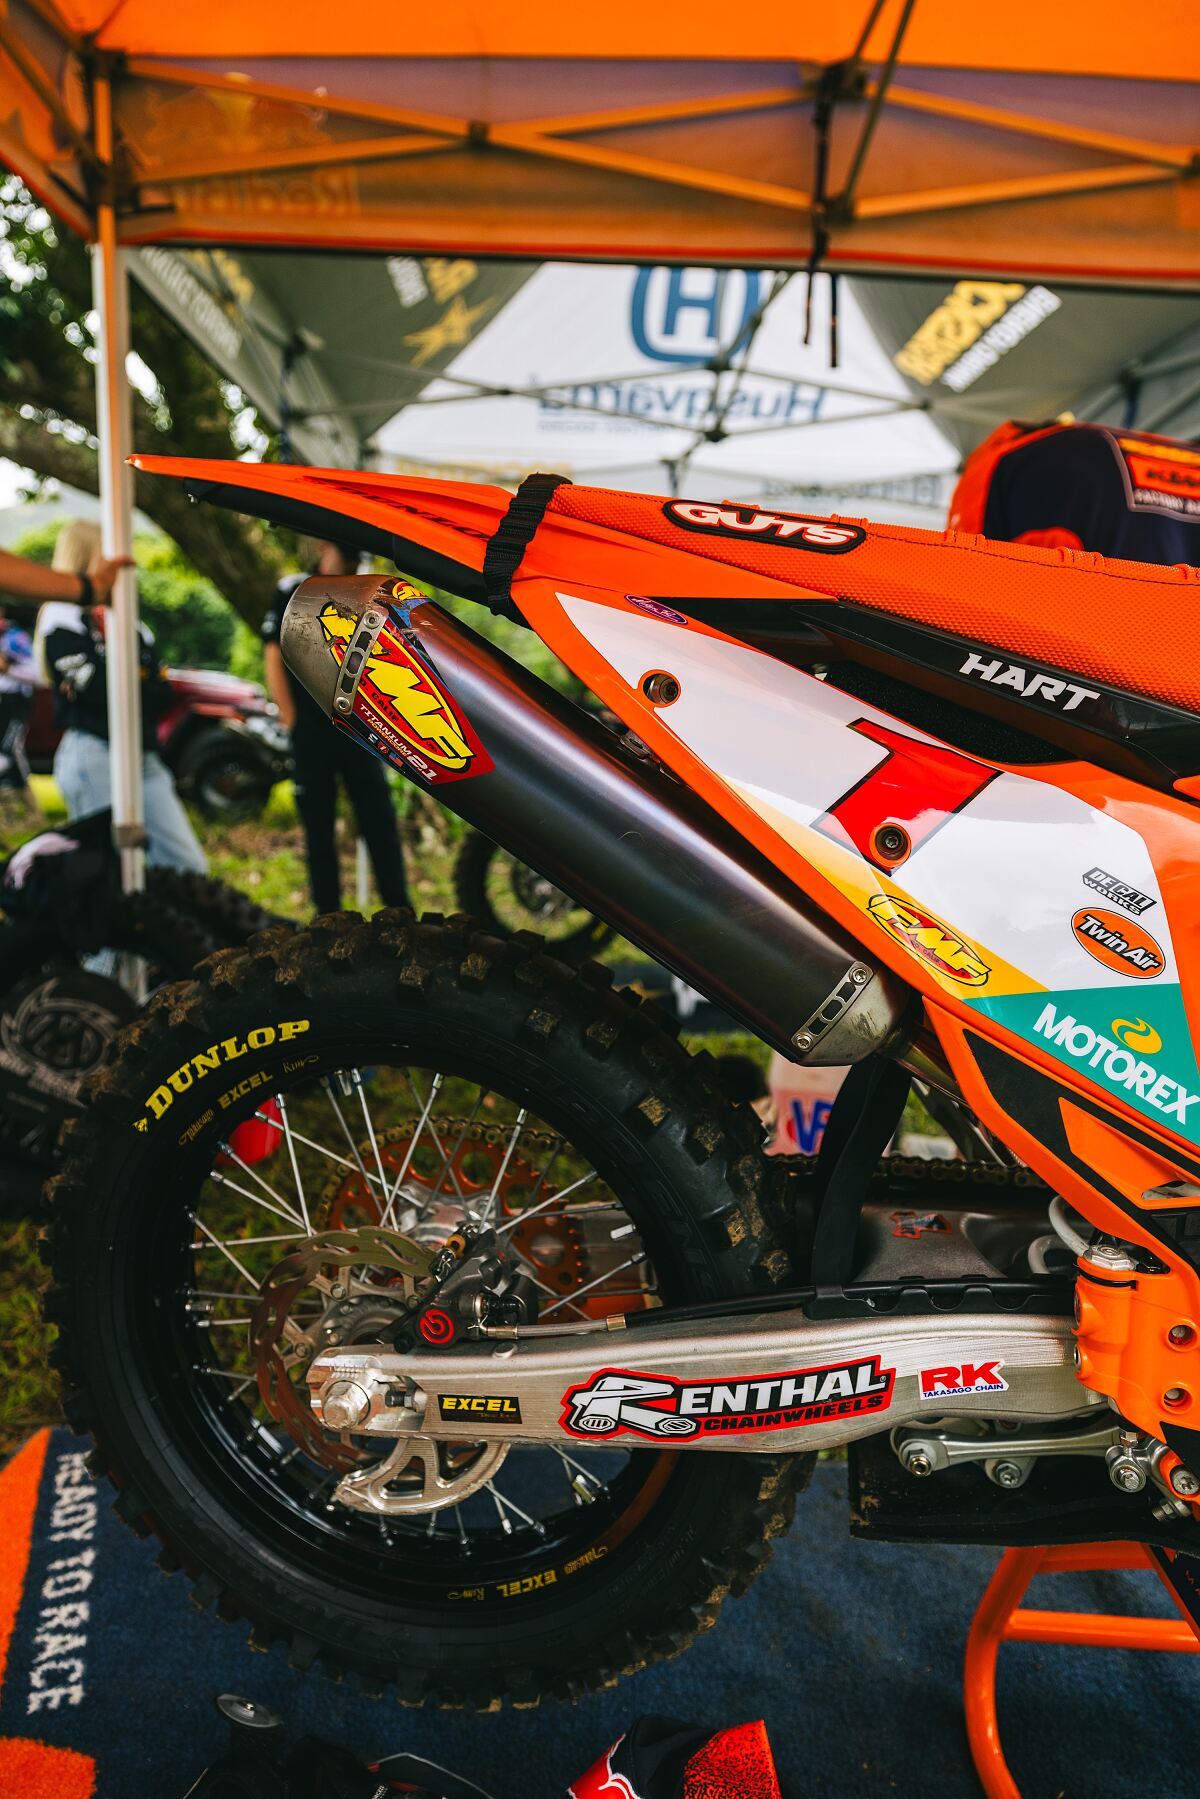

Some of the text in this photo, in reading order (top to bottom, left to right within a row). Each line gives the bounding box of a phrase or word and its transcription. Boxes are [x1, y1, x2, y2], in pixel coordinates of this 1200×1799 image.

[673, 504, 856, 544] GUTS
[959, 653, 1101, 711] HART
[360, 703, 412, 755] TITANIUM
[811, 717, 1005, 876] 1
[1083, 877, 1142, 916] WORKS
[1088, 870, 1152, 909] DECAL
[866, 898, 993, 978] FMF
[1078, 914, 1161, 970] Twin Air
[144, 1019, 310, 1121] DUNLOP
[1032, 1002, 1200, 1126] MOTOREX
[217, 1070, 274, 1110] EXCEL
[920, 1361, 1003, 1393] RK
[923, 1383, 1004, 1398] TAKASAGO CHAIN
[442, 1397, 517, 1412] EXCEL
[571, 1364, 886, 1437] RENTHAL
[704, 1395, 883, 1431] CHAINWHEELS
[27, 1450, 97, 1714] READY TO RACE
[496, 1569, 558, 1597] EXCEL
